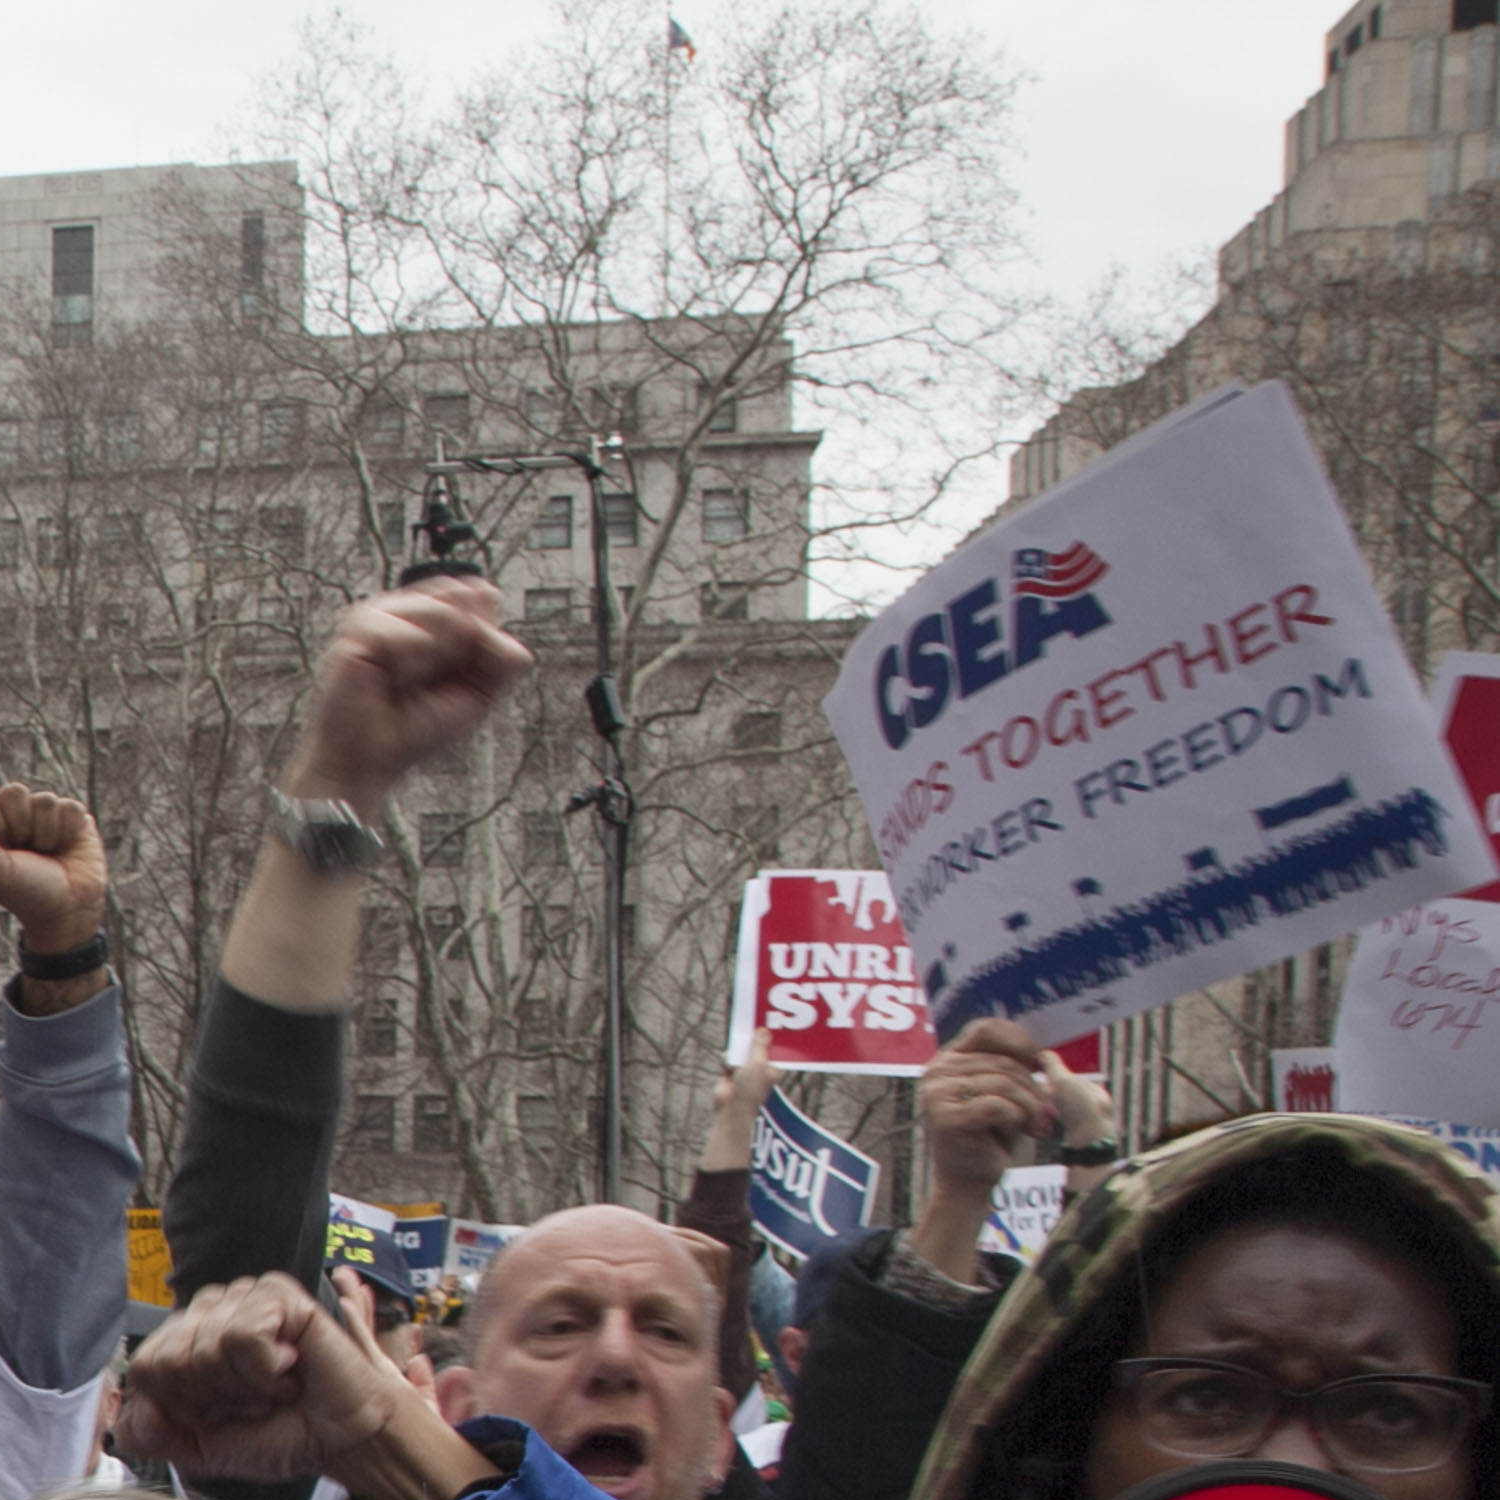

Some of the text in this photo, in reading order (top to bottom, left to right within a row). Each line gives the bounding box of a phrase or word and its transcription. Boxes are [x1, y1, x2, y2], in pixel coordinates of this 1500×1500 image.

[873, 576, 1114, 750] CSEA
[960, 584, 1336, 784] TOGETHER
[1072, 656, 1374, 822] FREEDOM
[768, 942, 914, 981] UNRI
[751, 1115, 838, 1237] ysut
